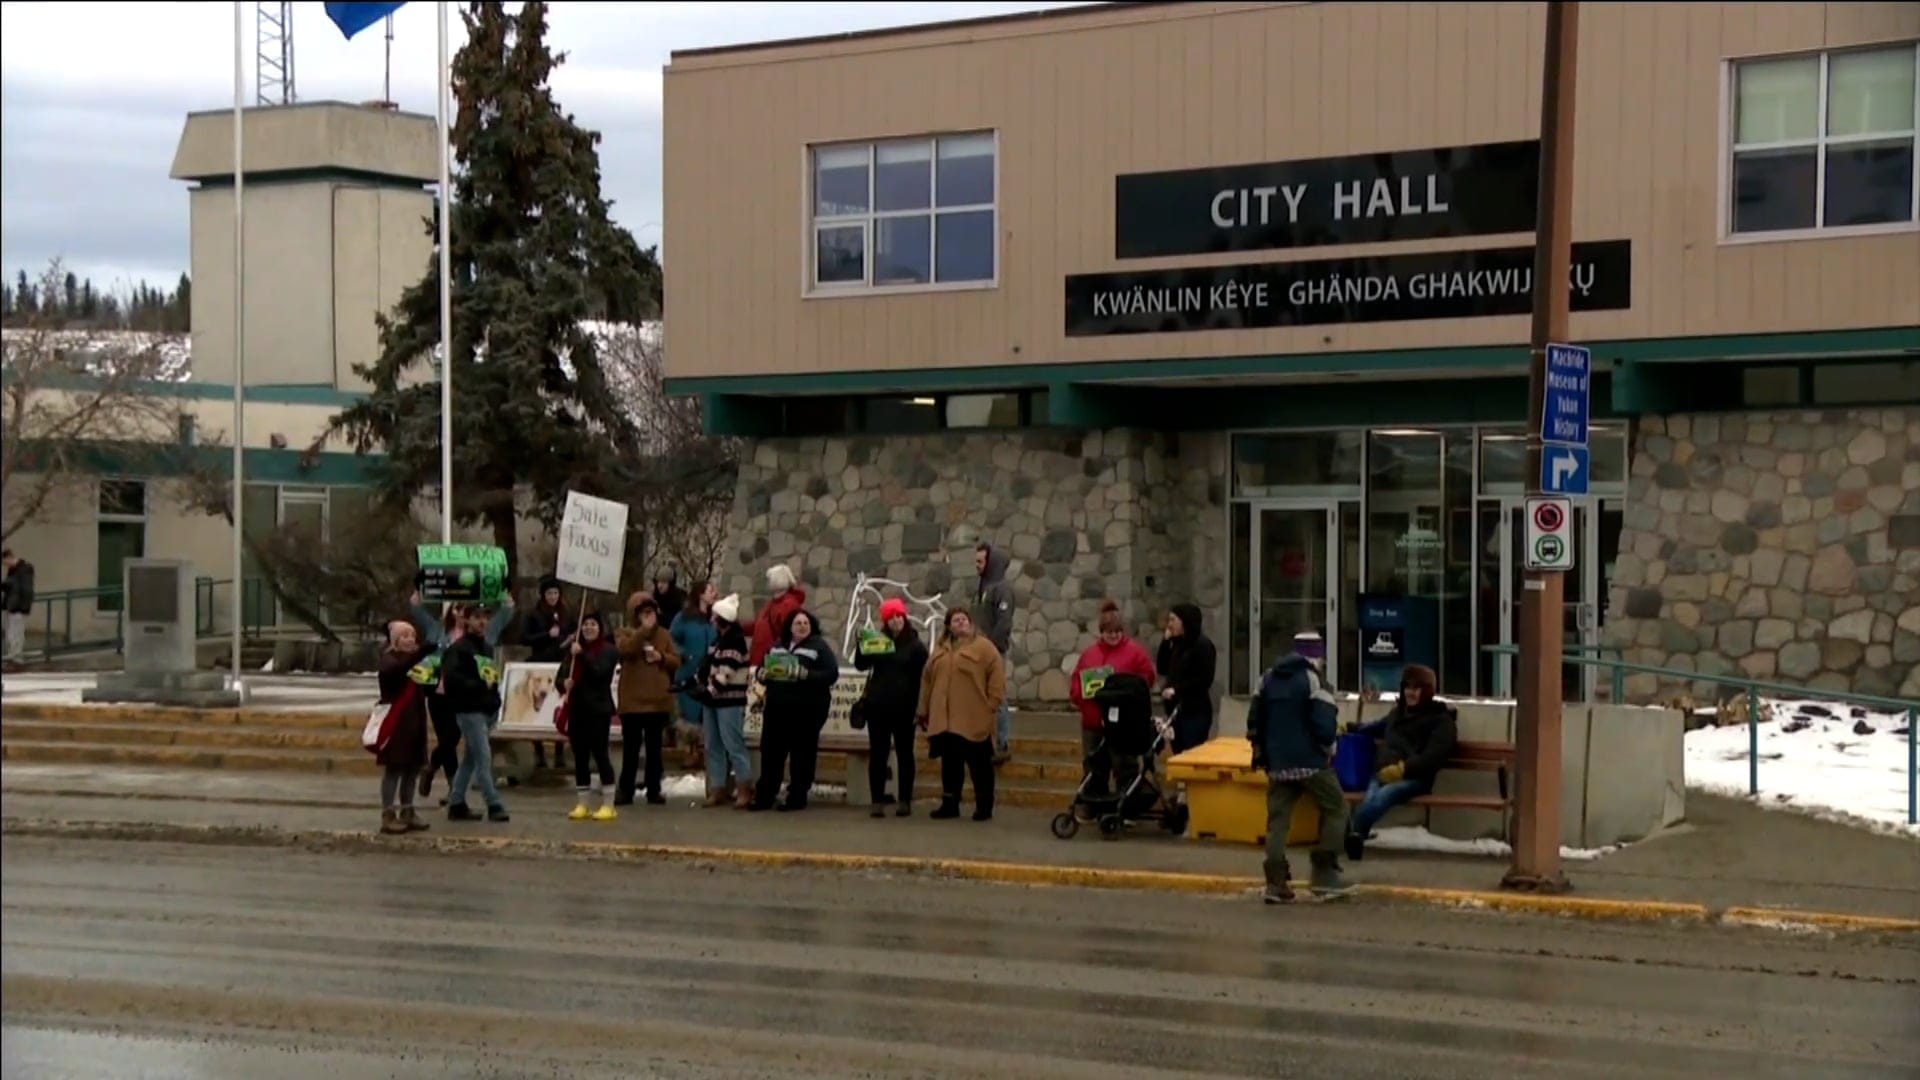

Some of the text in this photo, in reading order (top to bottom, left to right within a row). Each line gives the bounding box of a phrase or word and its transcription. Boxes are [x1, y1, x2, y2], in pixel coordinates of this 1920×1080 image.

[1211, 174, 1449, 228] CITY HALL
[1093, 285, 1201, 316] KWÄNLIN
[1209, 279, 1269, 310] KÊYE
[1288, 273, 1400, 305] GHÄNDA
[1548, 371, 1578, 391] Museum
[1557, 395, 1579, 415] Yukon
[1553, 417, 1580, 441] History
